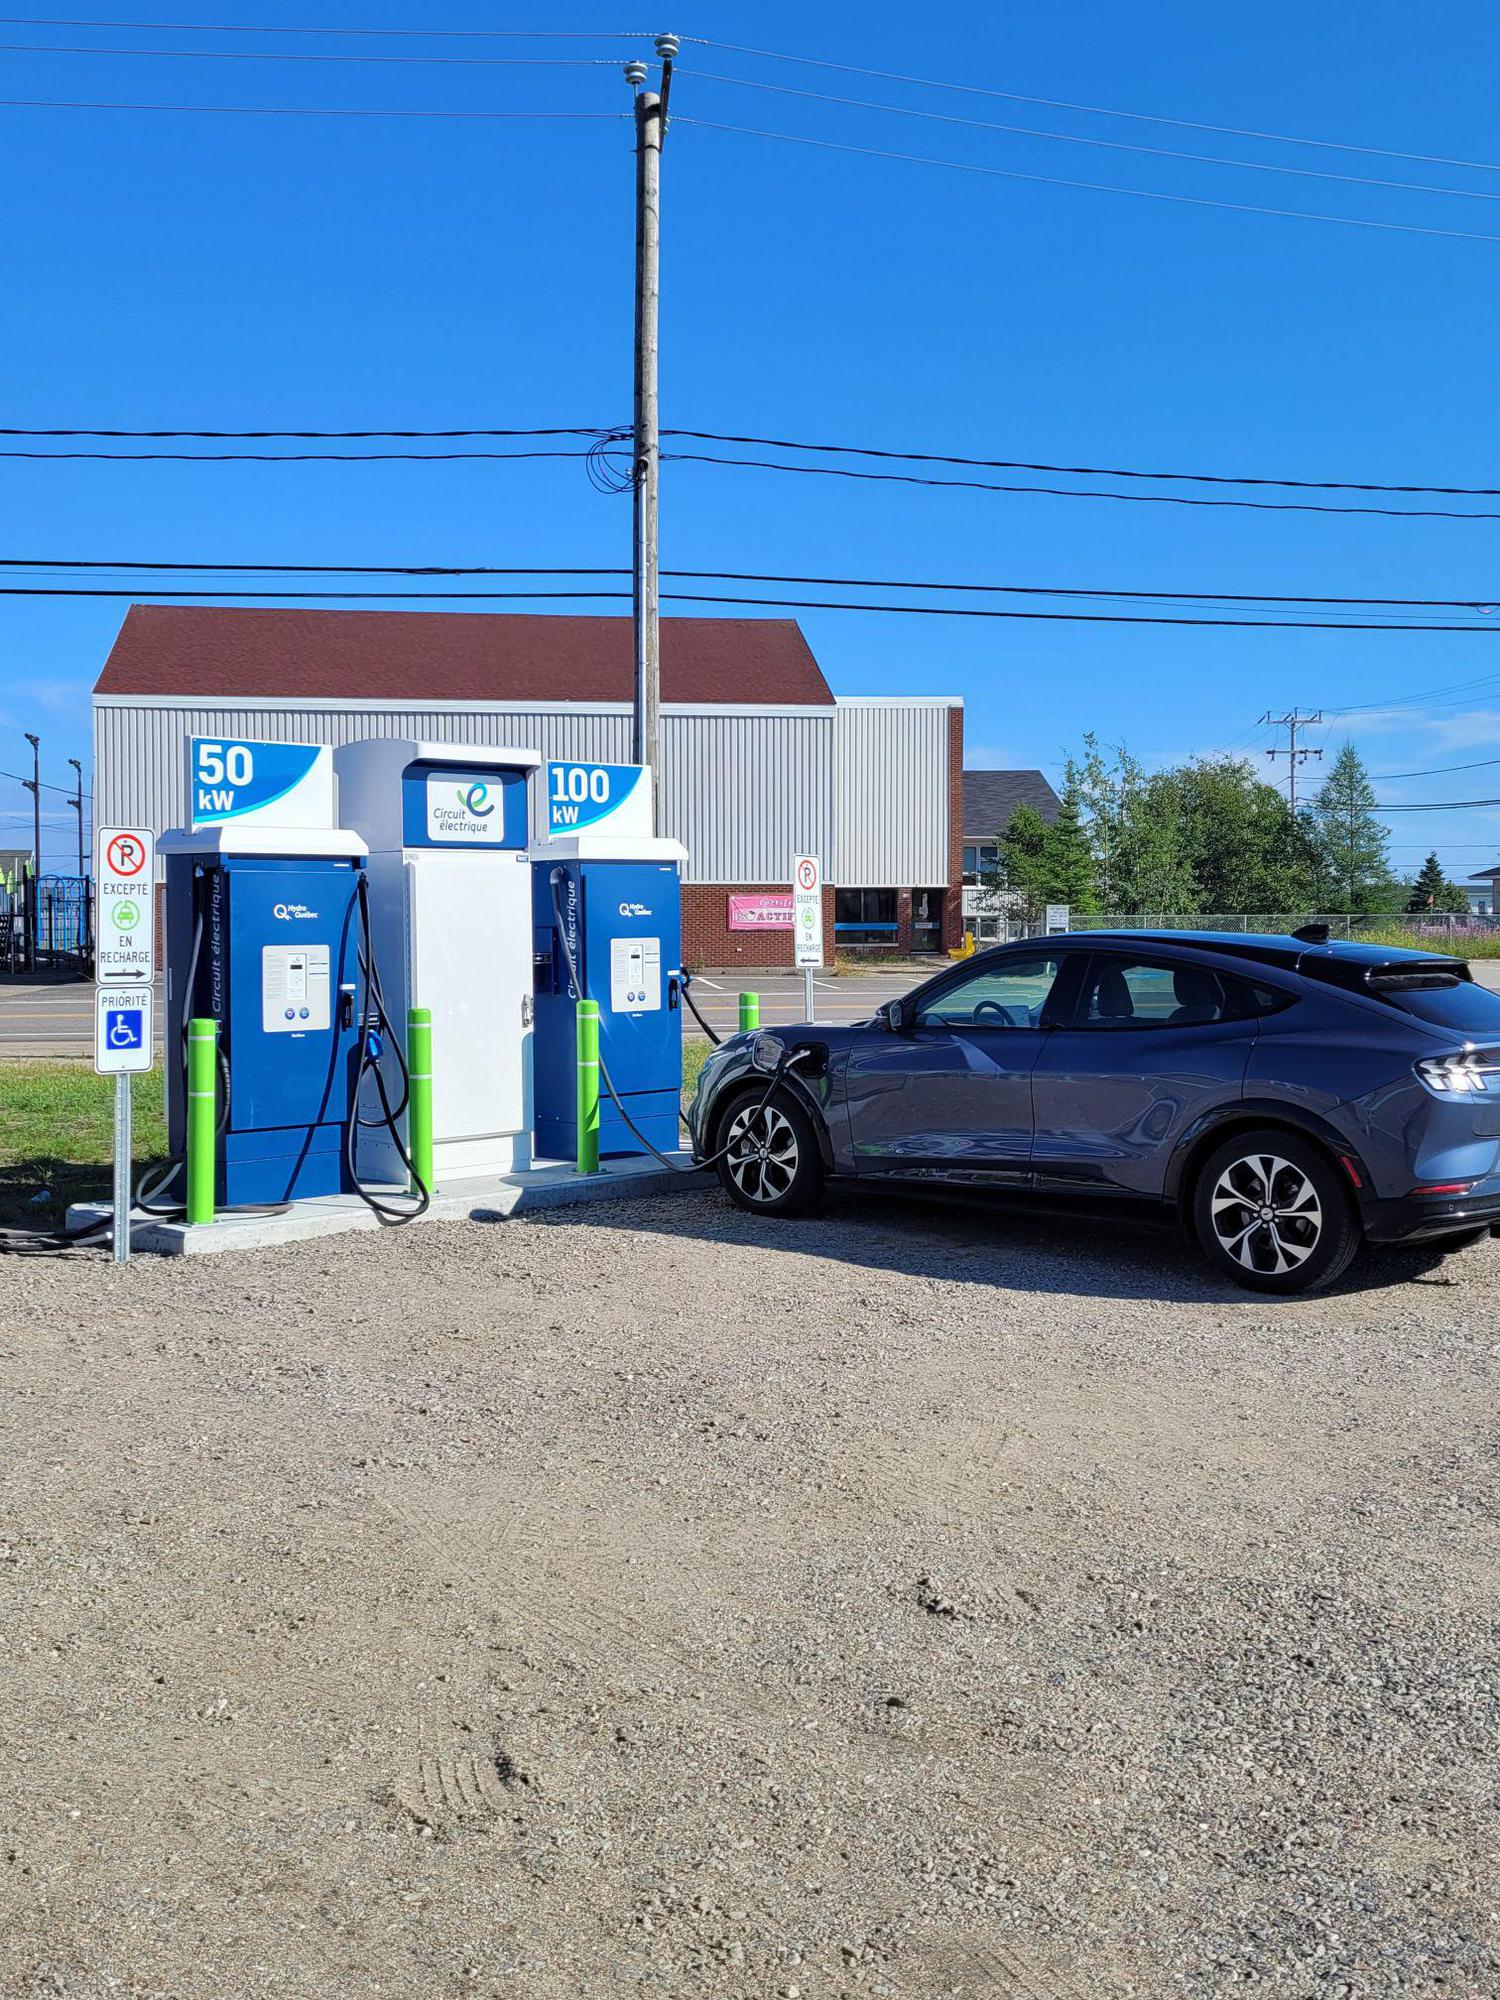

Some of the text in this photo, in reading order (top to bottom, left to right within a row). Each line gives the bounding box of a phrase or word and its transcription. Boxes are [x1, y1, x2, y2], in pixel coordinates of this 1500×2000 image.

[198, 744, 253, 786] 50
[552, 767, 610, 804] 100
[198, 789, 234, 811] kW
[433, 808, 466, 820] Circuit
[552, 805, 579, 824] kW
[439, 820, 488, 834] électrique
[288, 904, 307, 912] Hydro
[119, 936, 132, 947] EN
[211, 874, 222, 1012] Circuit électrique
[567, 881, 577, 999] Ciuit électrique
[805, 932, 813, 941] EN
[796, 943, 821, 953] RECHARGE
[100, 951, 151, 963] RECHARGE
[101, 993, 147, 1007] PRIORITÉ
